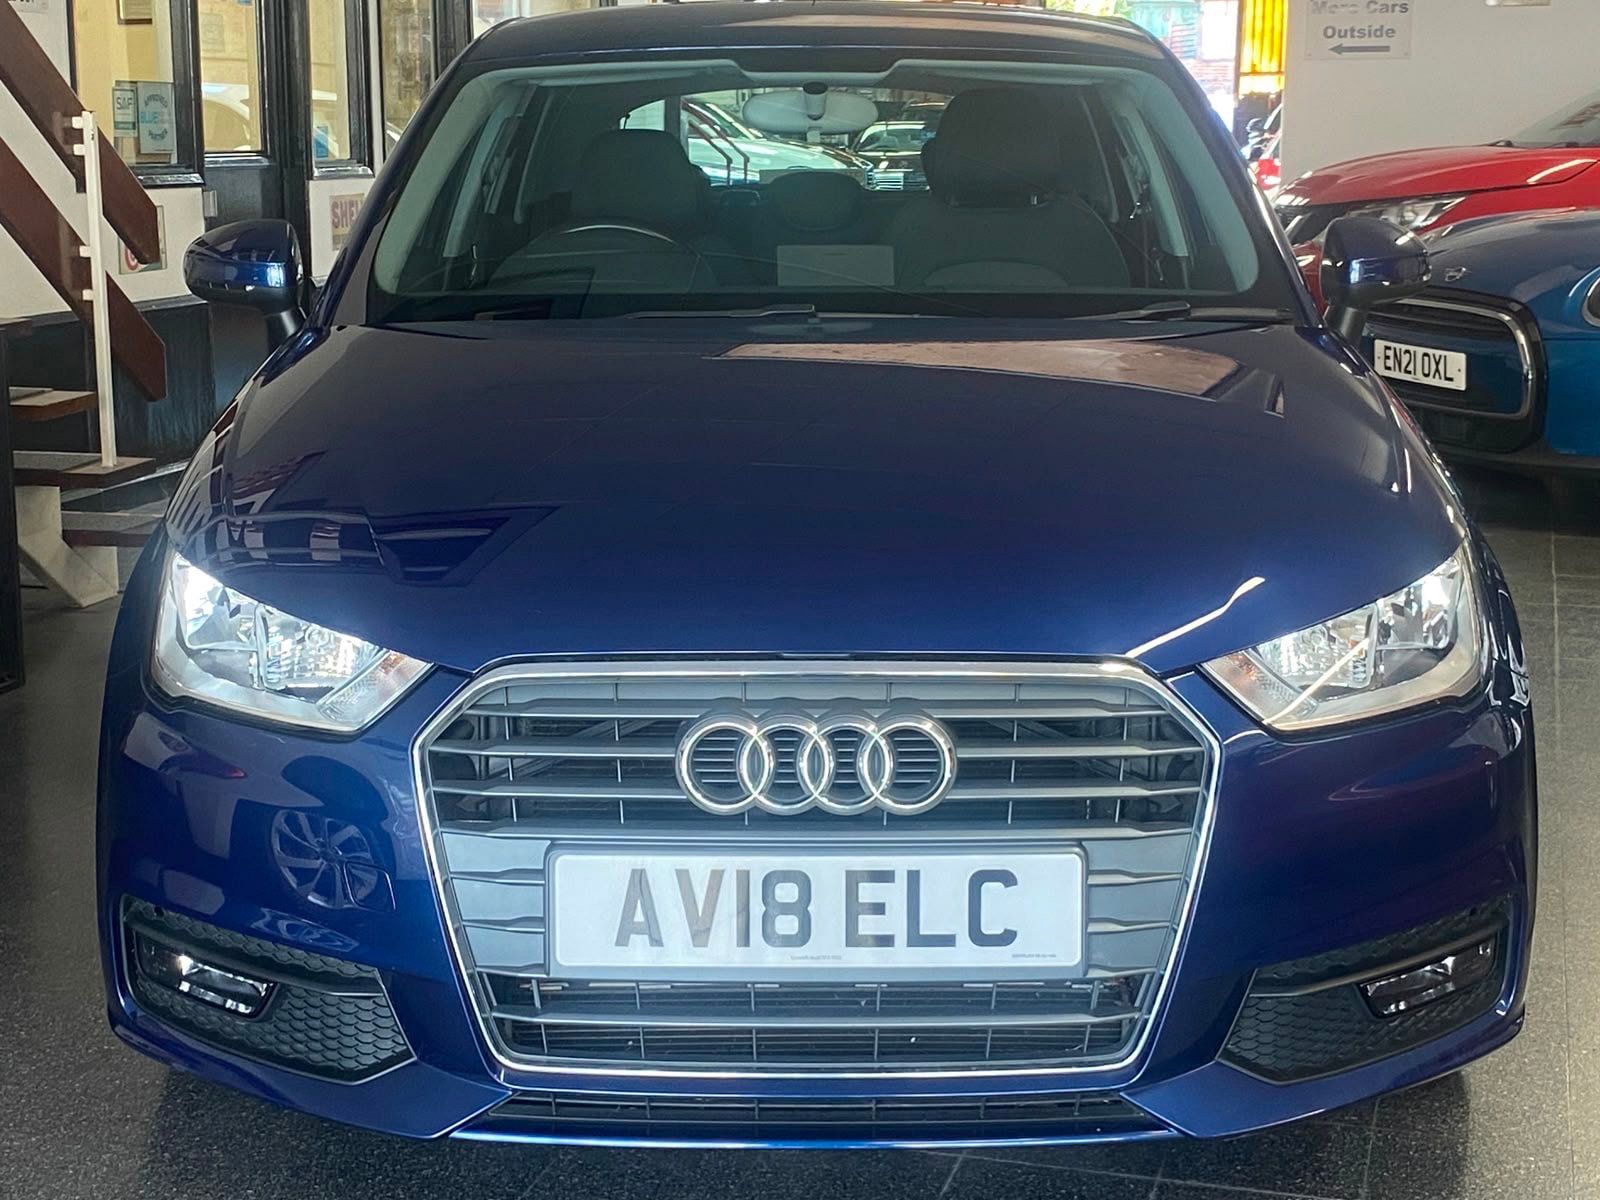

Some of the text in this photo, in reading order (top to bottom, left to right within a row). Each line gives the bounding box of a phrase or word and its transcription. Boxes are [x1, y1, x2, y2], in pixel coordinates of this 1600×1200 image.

[1366, 0, 1409, 14] Cars
[1323, 24, 1396, 39] Outside
[1384, 345, 1454, 382] EN21 OXL
[614, 868, 1019, 948] AV18 ELC
